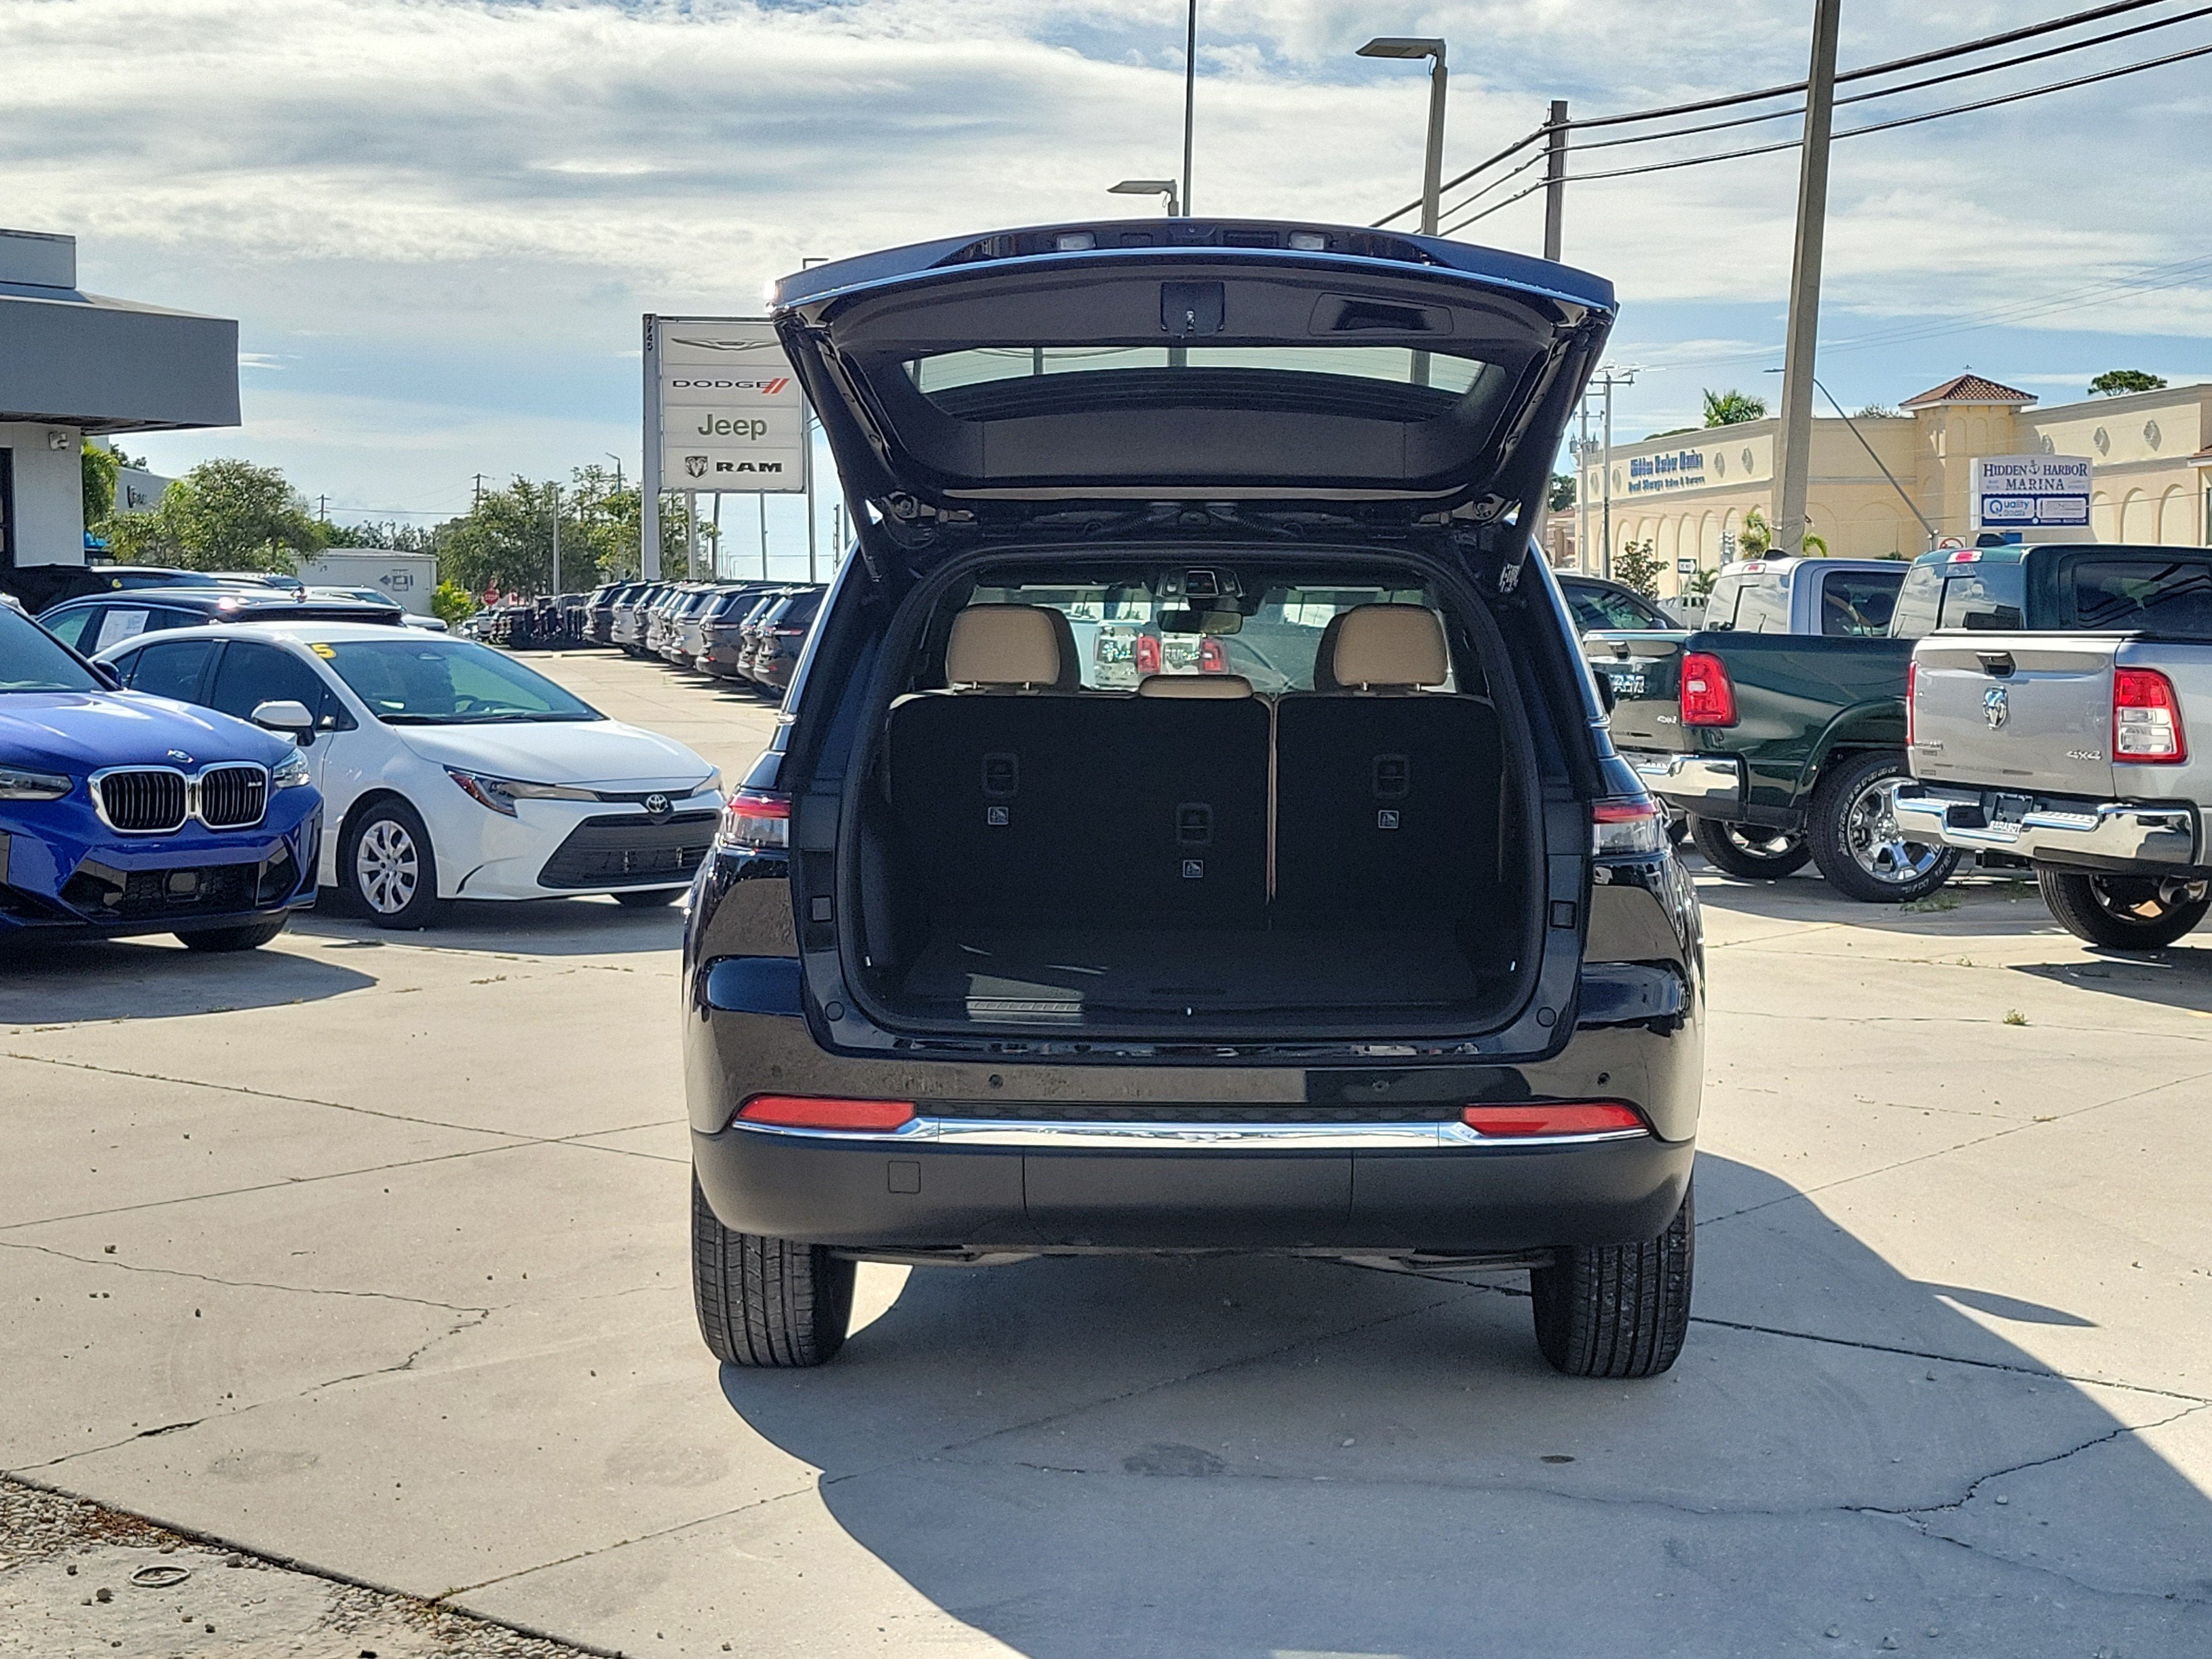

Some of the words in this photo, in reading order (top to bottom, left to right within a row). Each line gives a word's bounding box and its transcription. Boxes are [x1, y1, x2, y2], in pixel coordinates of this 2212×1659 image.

[673, 380, 773, 388] DODGE
[698, 414, 768, 441] Jeep
[716, 462, 782, 472] RAM
[1983, 464, 2027, 477] HIDDEN
[2043, 463, 2087, 476] HARBOR
[2006, 478, 2064, 490] MARINA
[311, 644, 336, 659] 5
[2066, 750, 2102, 760] 4x4
